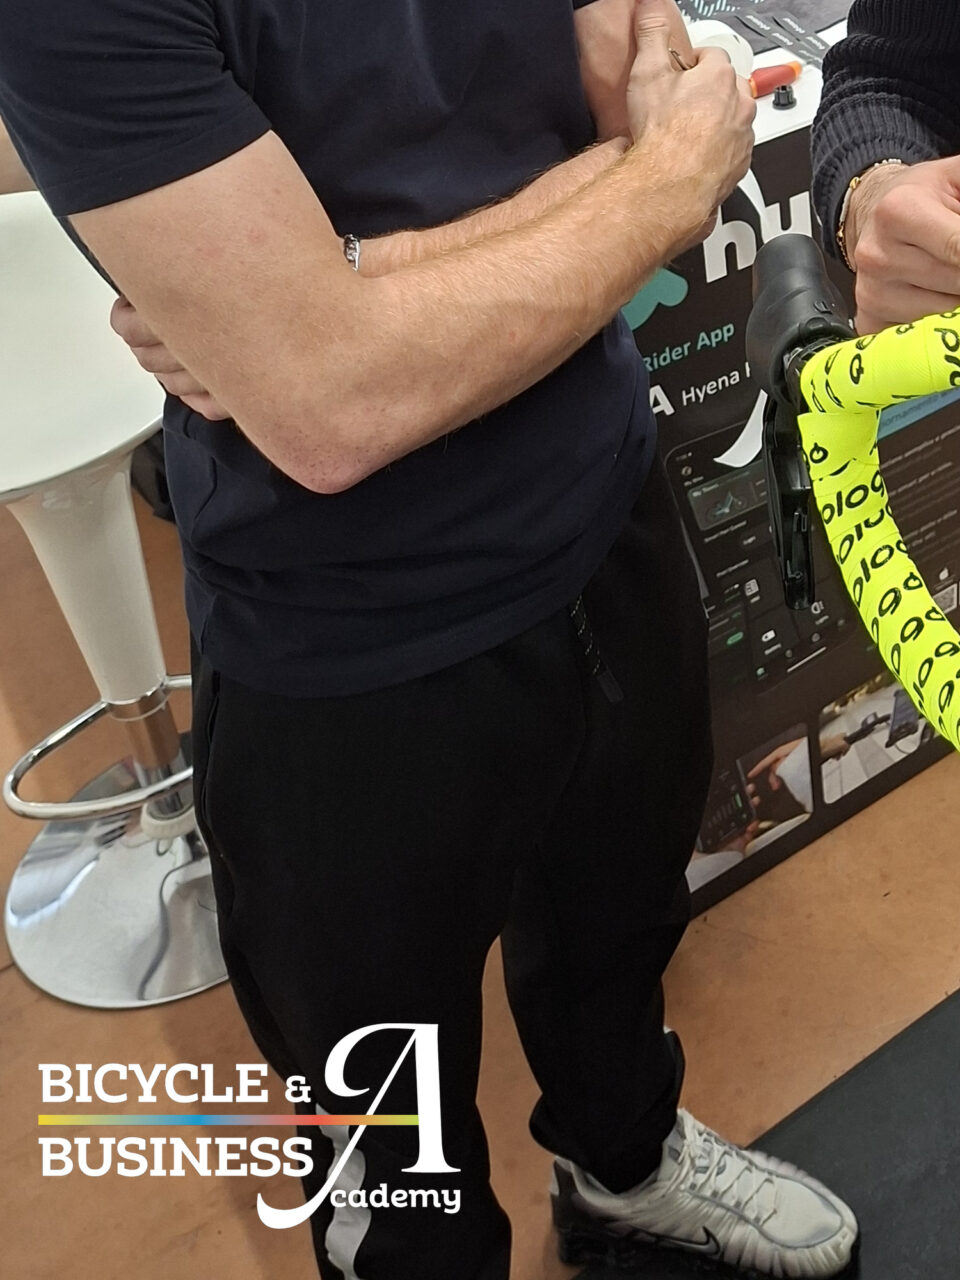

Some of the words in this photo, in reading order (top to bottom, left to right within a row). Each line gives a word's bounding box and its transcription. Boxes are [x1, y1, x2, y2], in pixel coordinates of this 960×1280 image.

[643, 342, 690, 371] Rider
[696, 324, 735, 351] App
[682, 370, 740, 406] Hyena
